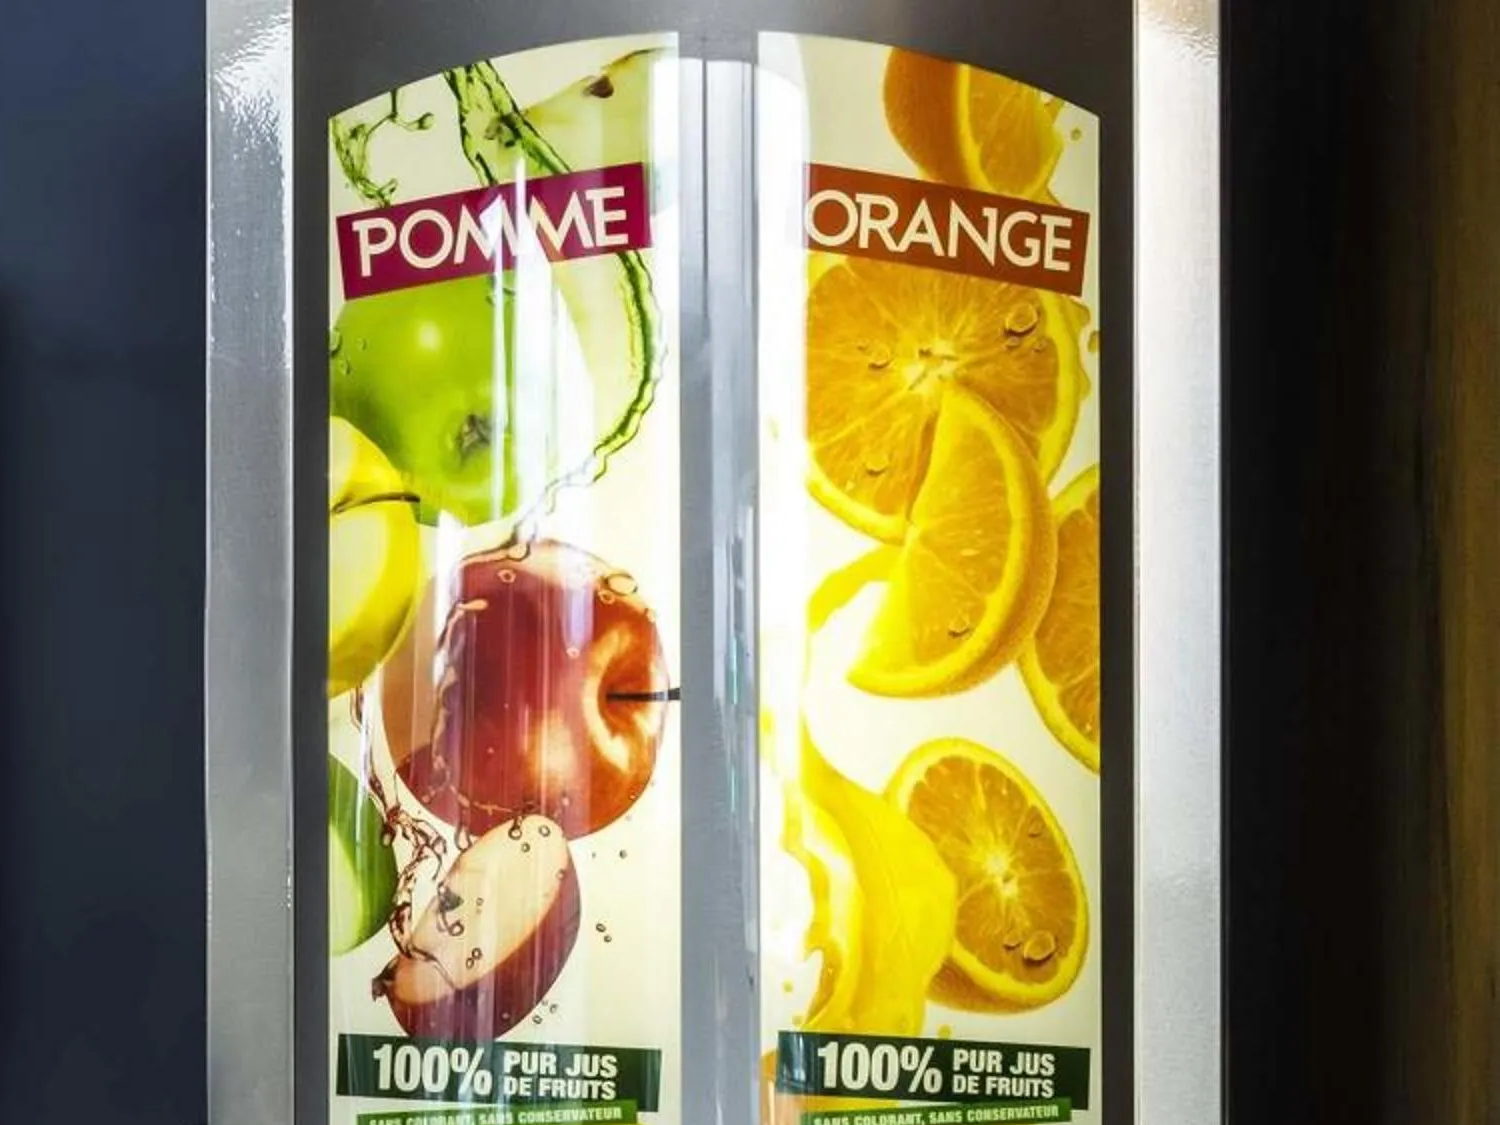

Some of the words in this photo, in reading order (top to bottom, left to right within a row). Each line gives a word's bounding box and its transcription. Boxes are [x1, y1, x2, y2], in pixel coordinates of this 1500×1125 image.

[350, 185, 629, 279] POMME
[803, 188, 1073, 273] ORANGE
[373, 1043, 493, 1096] 100%
[503, 1050, 558, 1076] PUR
[564, 1053, 618, 1079] JUS
[817, 1041, 943, 1095] 100%
[952, 1048, 1003, 1074] PUR
[1009, 1051, 1055, 1077] JUS
[952, 1075, 981, 1096] DE
[985, 1076, 1054, 1099] FRUITS
[503, 1076, 532, 1097] DE
[538, 1077, 617, 1101] FRUITS
[478, 1111, 513, 1125] SANS
[517, 1106, 623, 1125] CONSERVATEUR
[929, 1110, 962, 1125] SANS
[966, 1105, 1059, 1122] CONSERVATEUR
